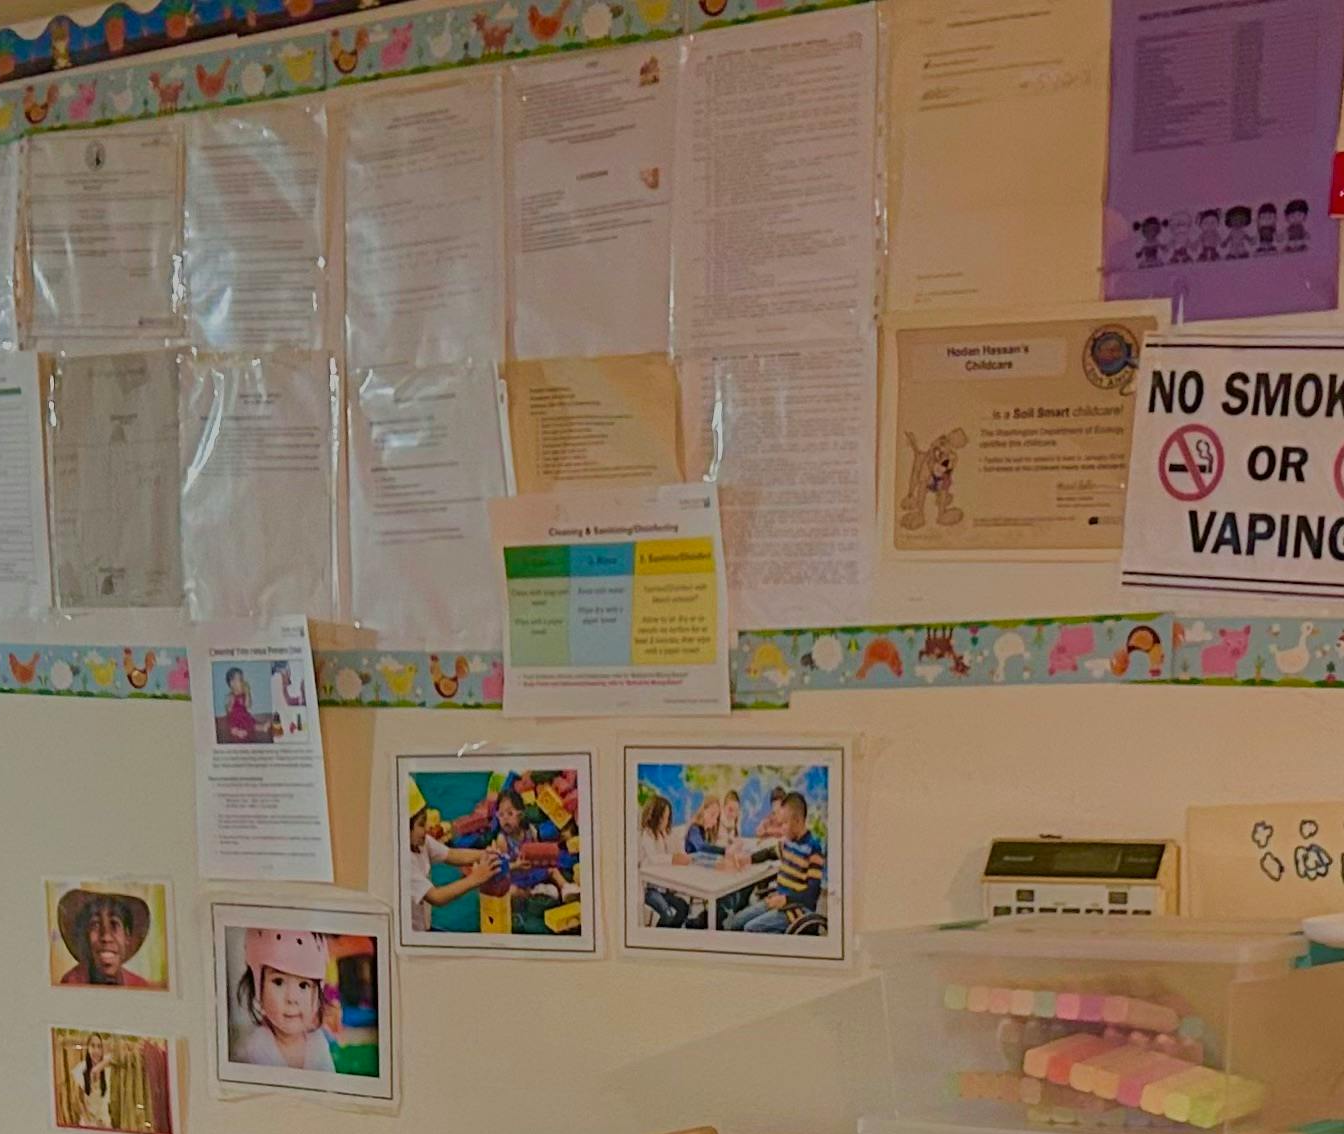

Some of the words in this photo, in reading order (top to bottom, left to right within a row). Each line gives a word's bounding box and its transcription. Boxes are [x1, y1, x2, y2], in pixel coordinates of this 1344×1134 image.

[965, 360, 1013, 371] Childcare
[1148, 370, 1204, 414] NO
[1012, 407, 1034, 419] Soil
[1037, 406, 1070, 418] Smart
[1247, 445, 1309, 482] OR
[548, 526, 583, 538] Cleaning
